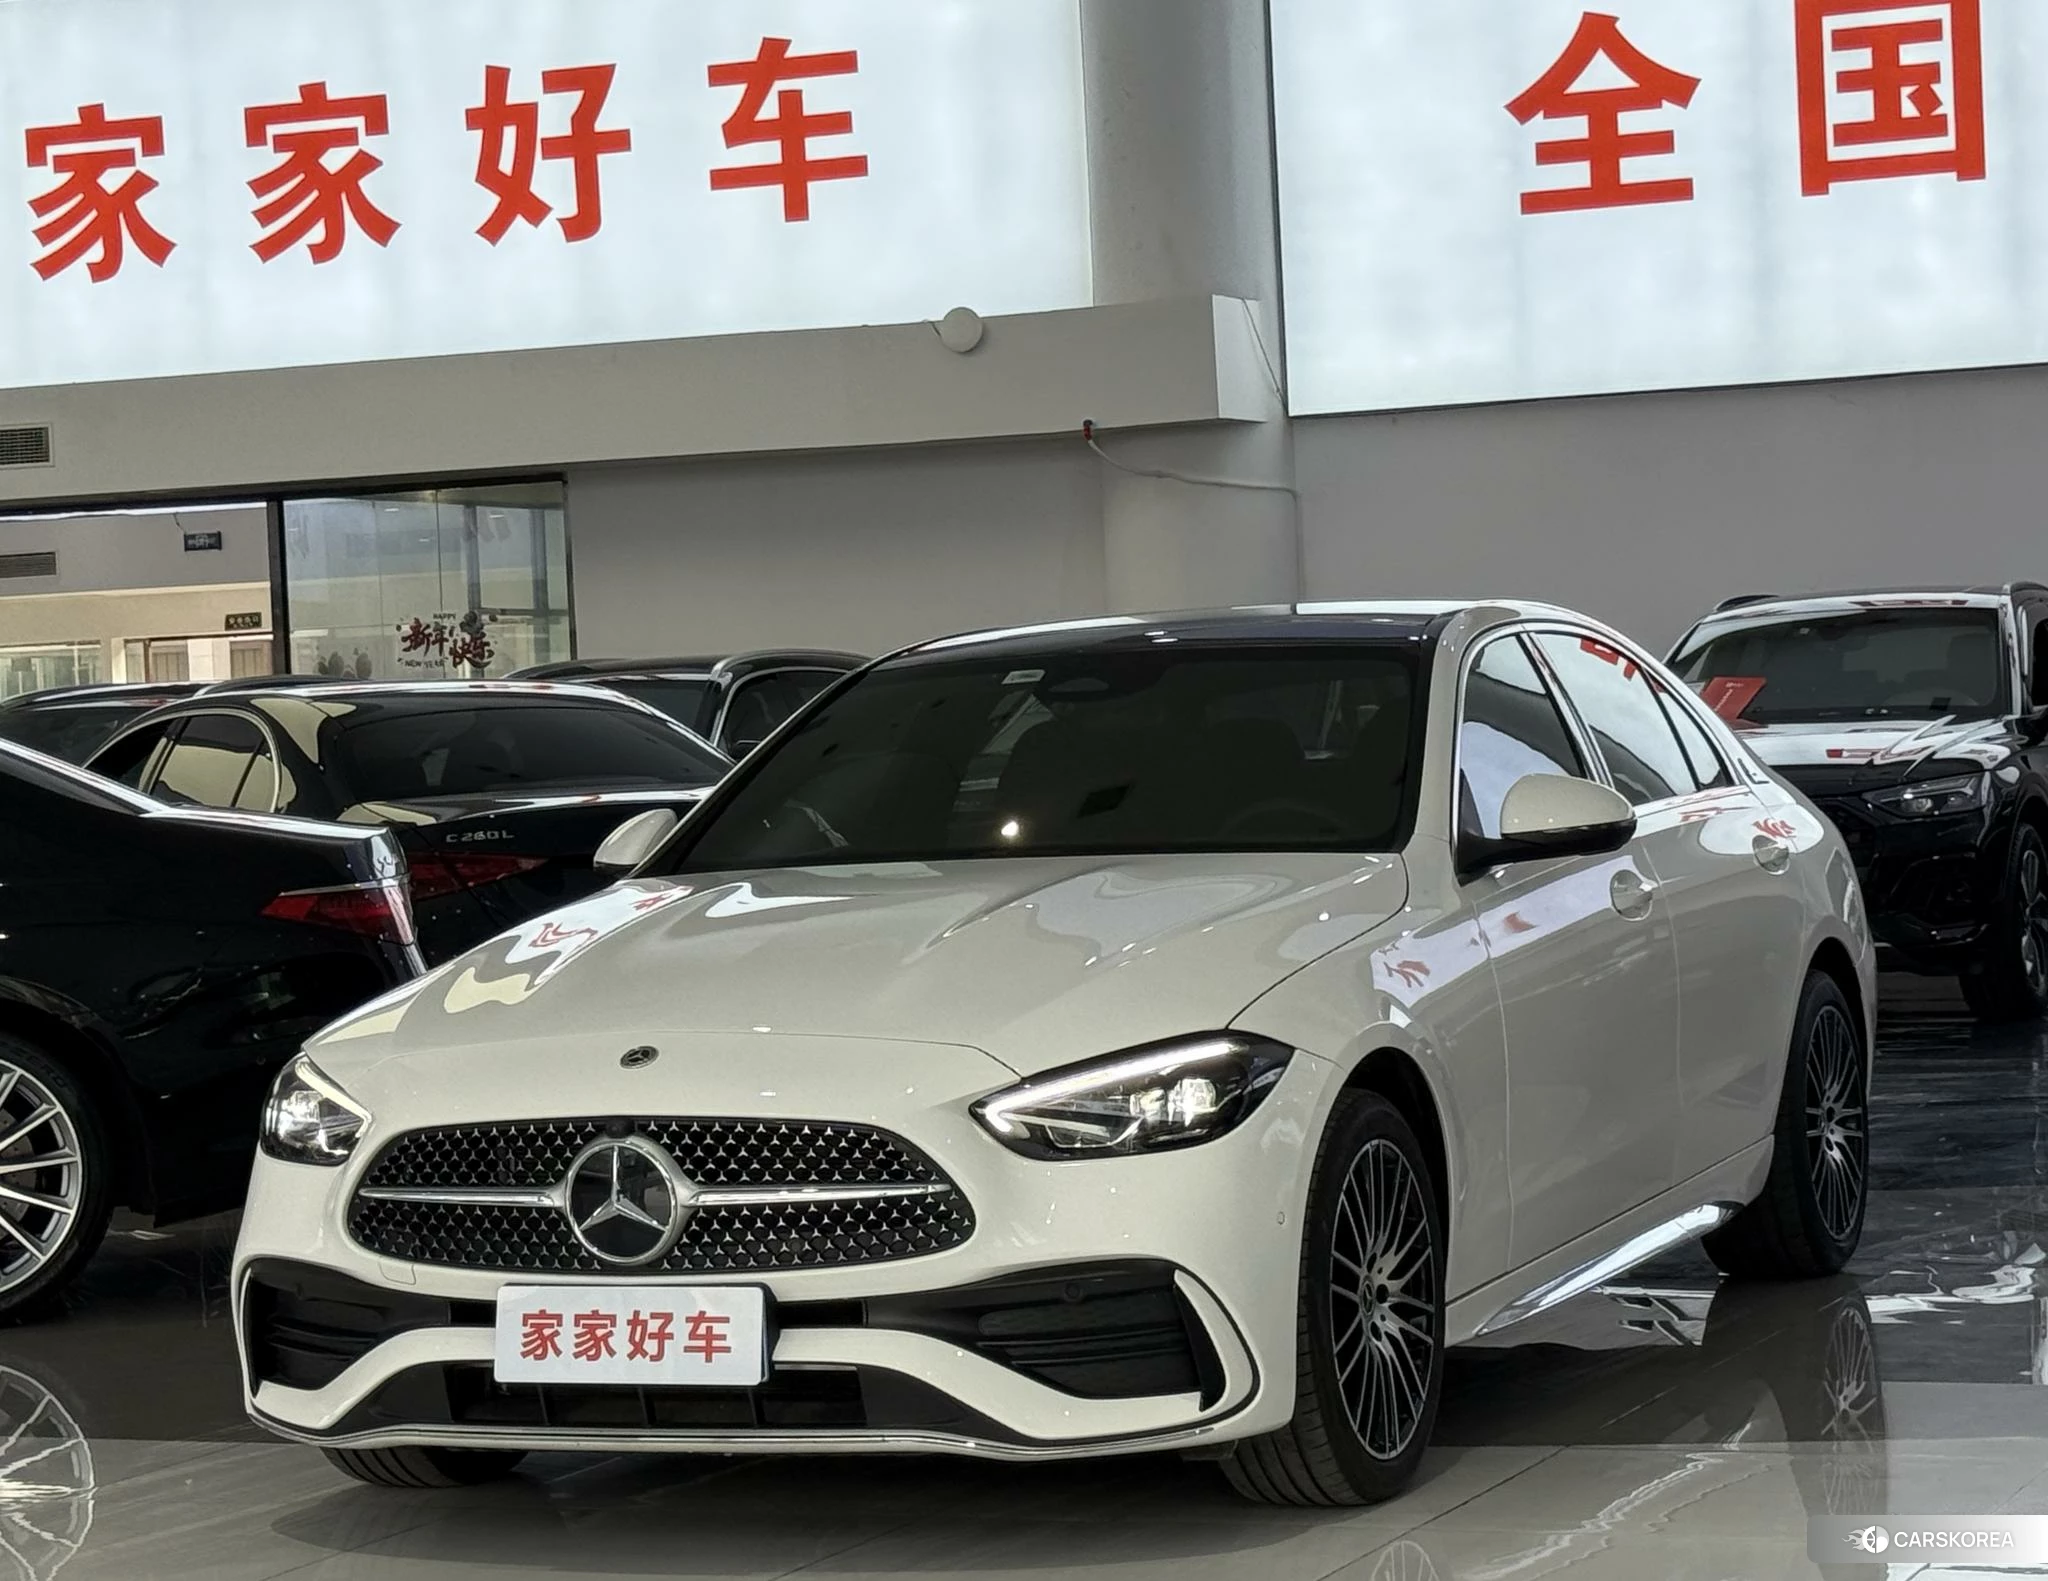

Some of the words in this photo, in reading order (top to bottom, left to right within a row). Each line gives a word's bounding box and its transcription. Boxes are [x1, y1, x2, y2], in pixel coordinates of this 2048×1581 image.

[25, 37, 868, 283] 家家好车
[1503, 0, 1986, 216] 全国
[519, 1308, 732, 1363] 家家好车
